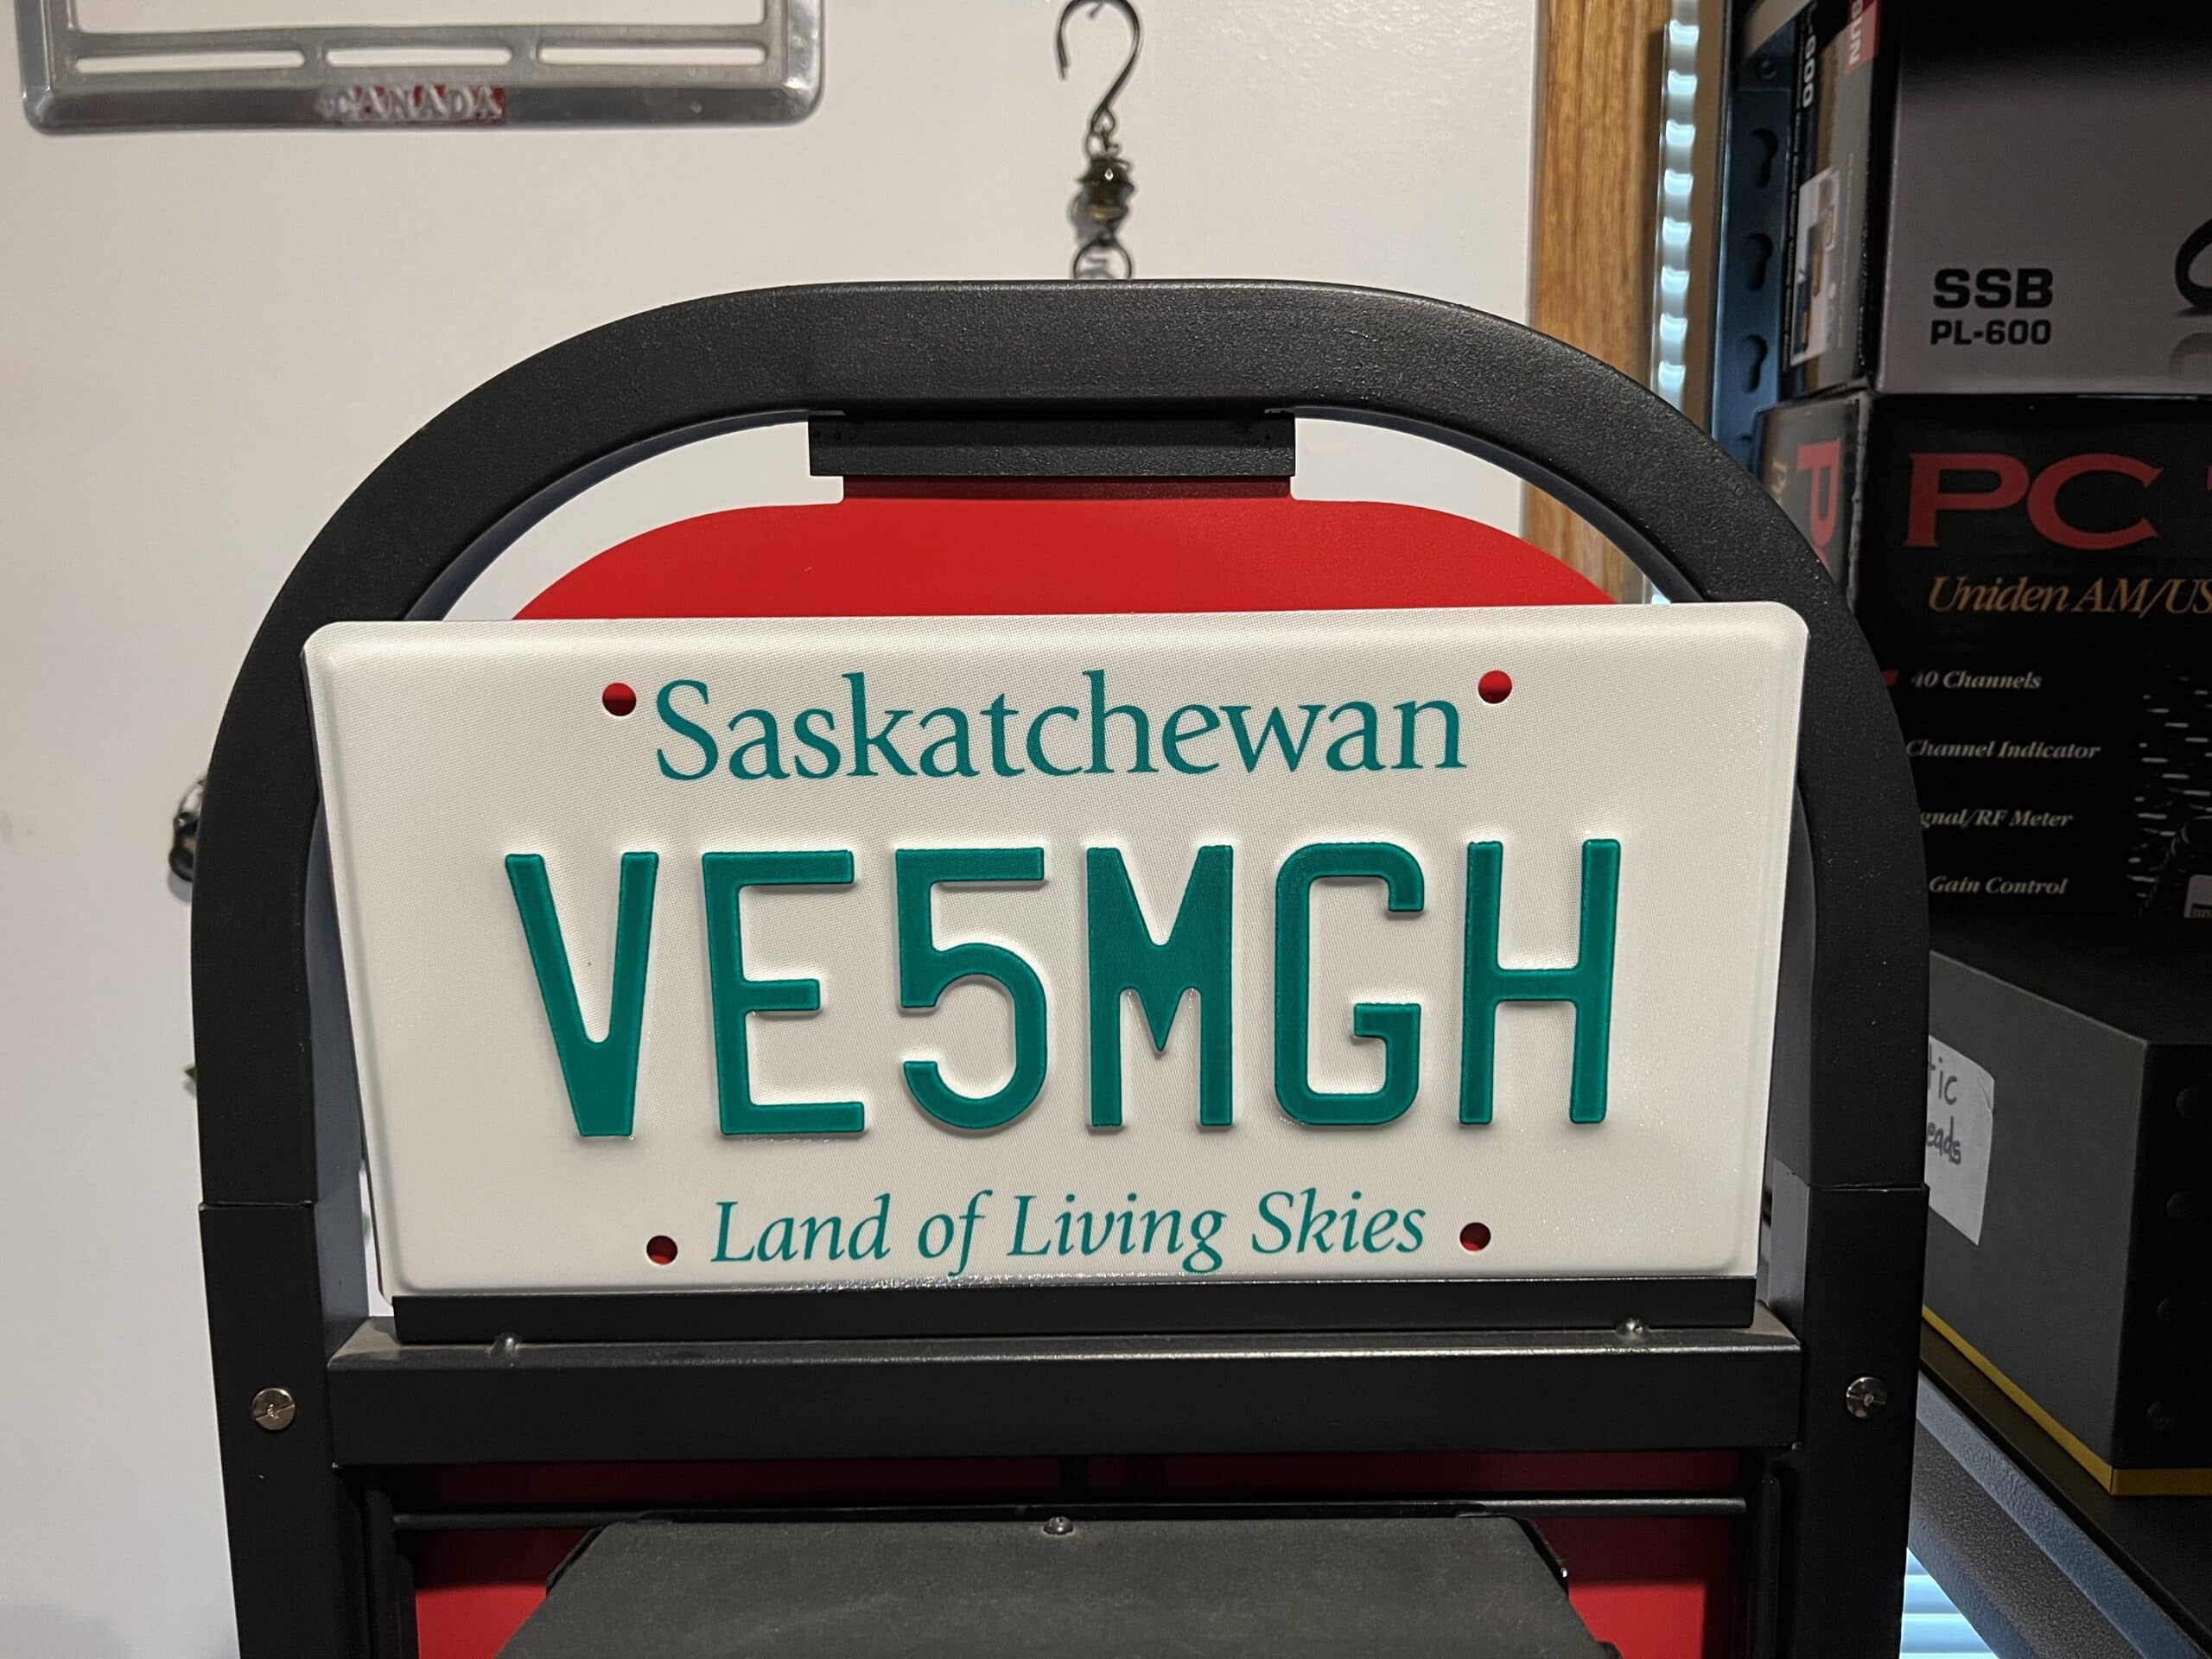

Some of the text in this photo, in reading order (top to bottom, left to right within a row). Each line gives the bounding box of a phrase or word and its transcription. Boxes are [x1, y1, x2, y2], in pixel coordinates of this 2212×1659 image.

[337, 84, 504, 123] CANADA
[1932, 267, 2054, 310] SSB
[1929, 318, 2052, 346] PL-600
[1904, 453, 2162, 550] PC
[1928, 575, 2071, 613] Uniden
[1910, 670, 2043, 690] 40 Channels
[657, 670, 1465, 781] Saskatchewan
[1906, 739, 2102, 760] Channel Indicator
[2009, 810, 2074, 828] Meter
[1929, 875, 2069, 895] Gain Control
[505, 838, 1622, 1138] VE5MGH
[712, 1187, 1427, 1277] Land of Living Skies
